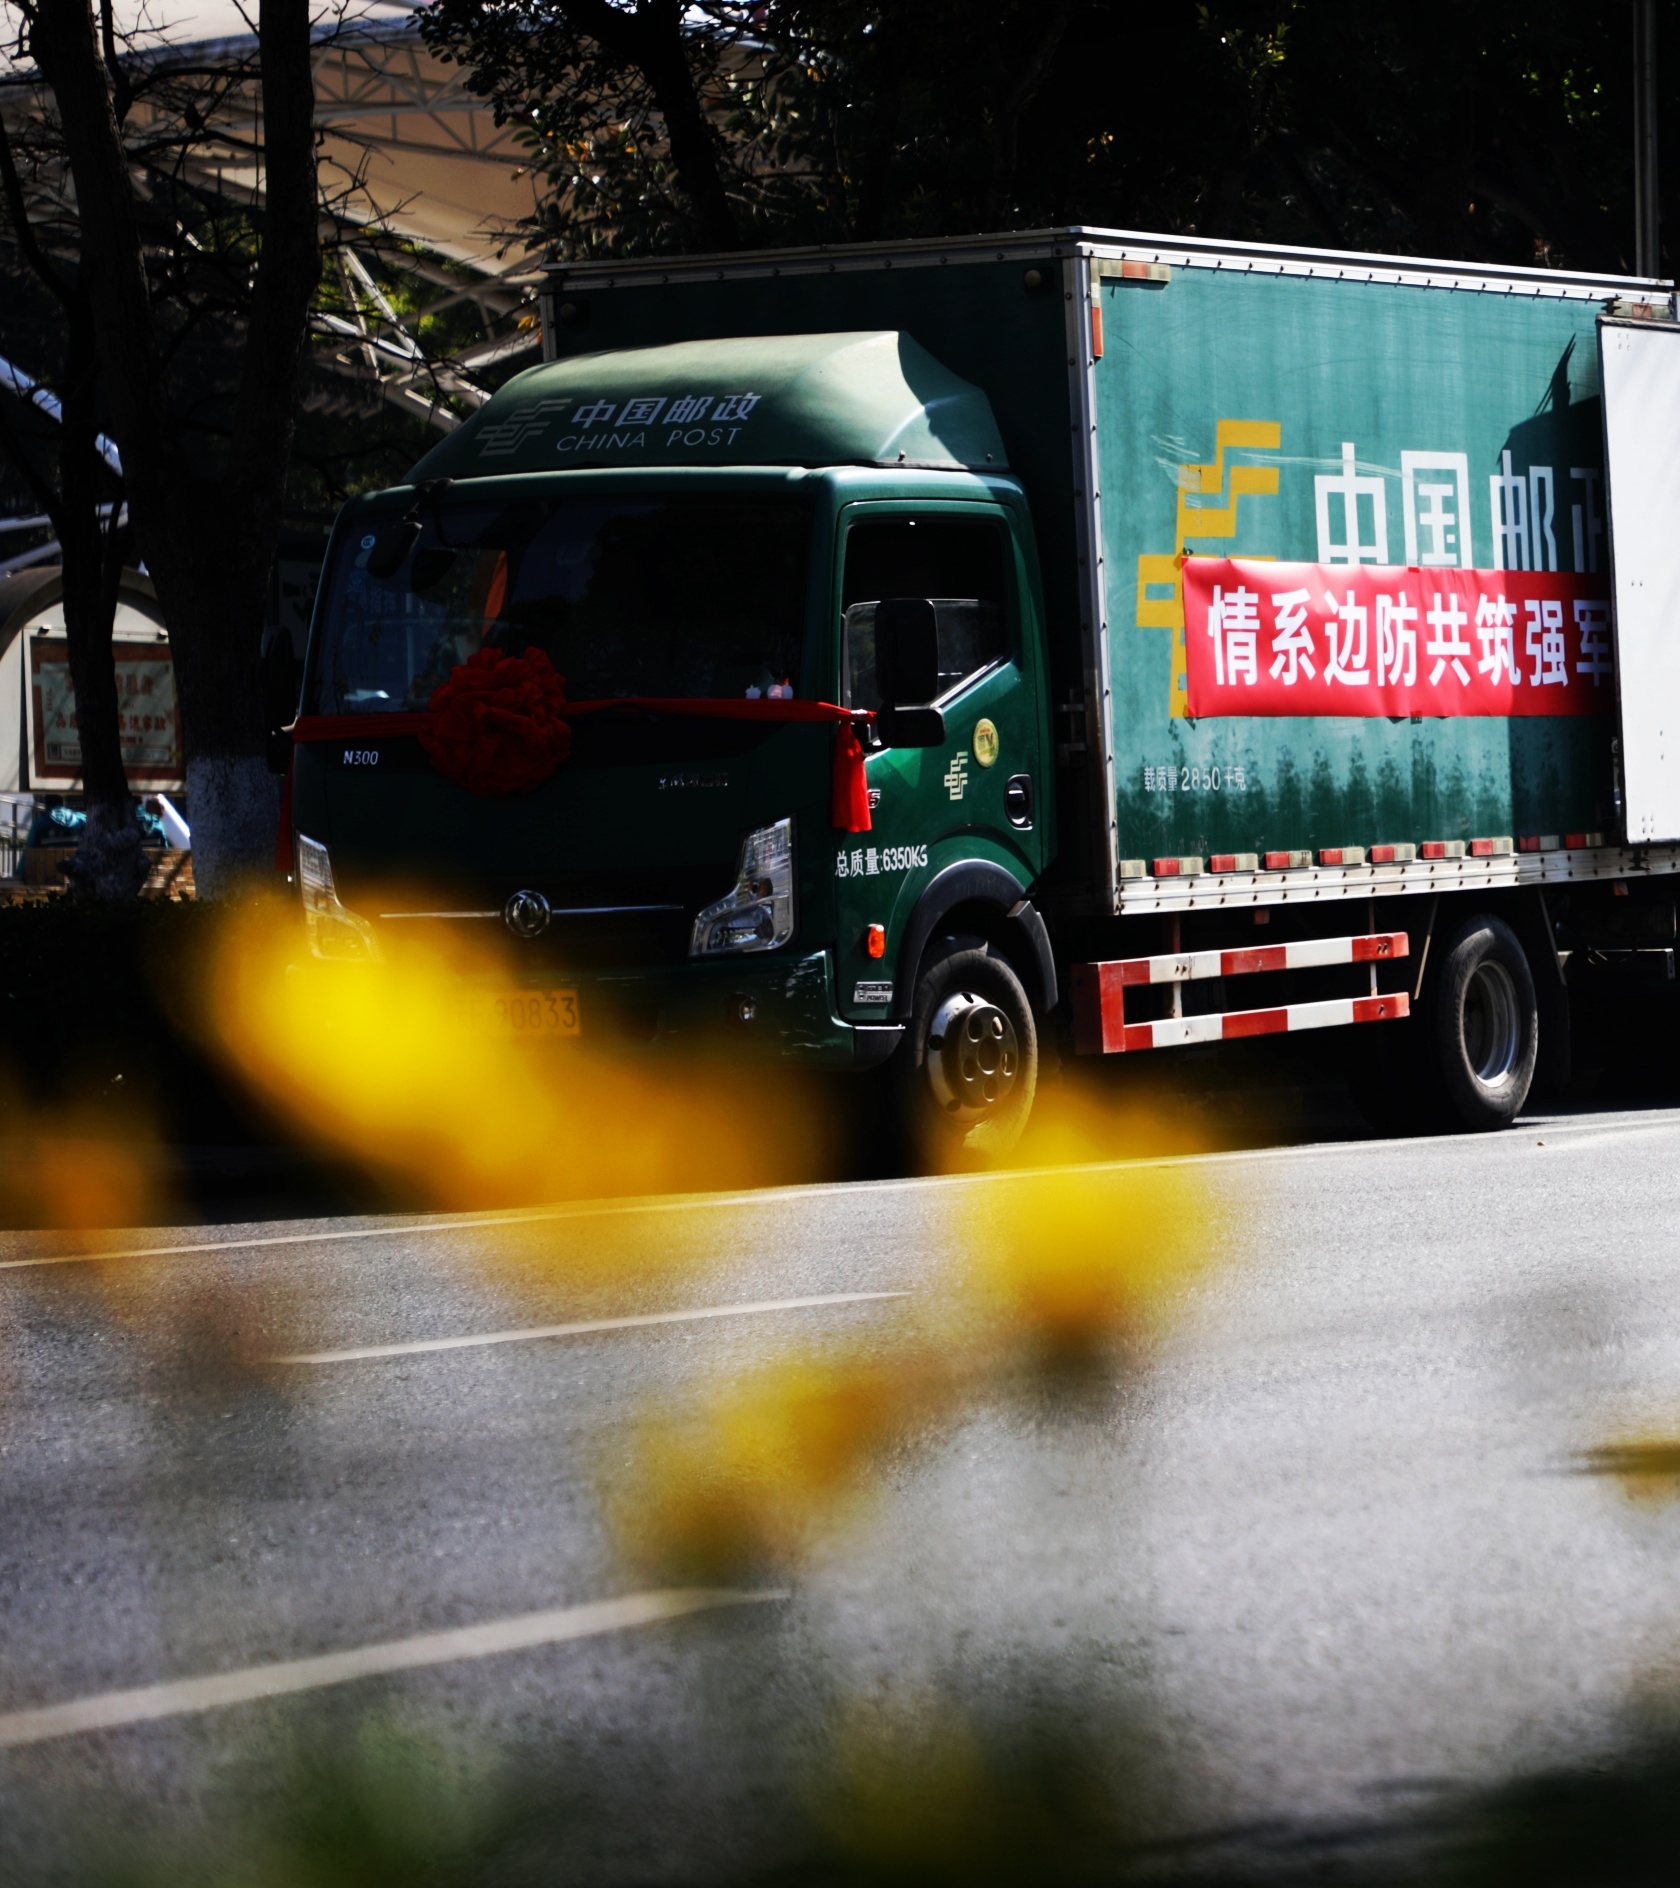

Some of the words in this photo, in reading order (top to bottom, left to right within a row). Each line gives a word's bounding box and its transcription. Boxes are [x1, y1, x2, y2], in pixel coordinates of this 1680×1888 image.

[572, 392, 762, 429] 中国邮政
[556, 431, 646, 452] CHINA
[666, 427, 743, 449] POST
[1207, 584, 1613, 688] 情系边防共筑强军
[343, 750, 379, 766] N300
